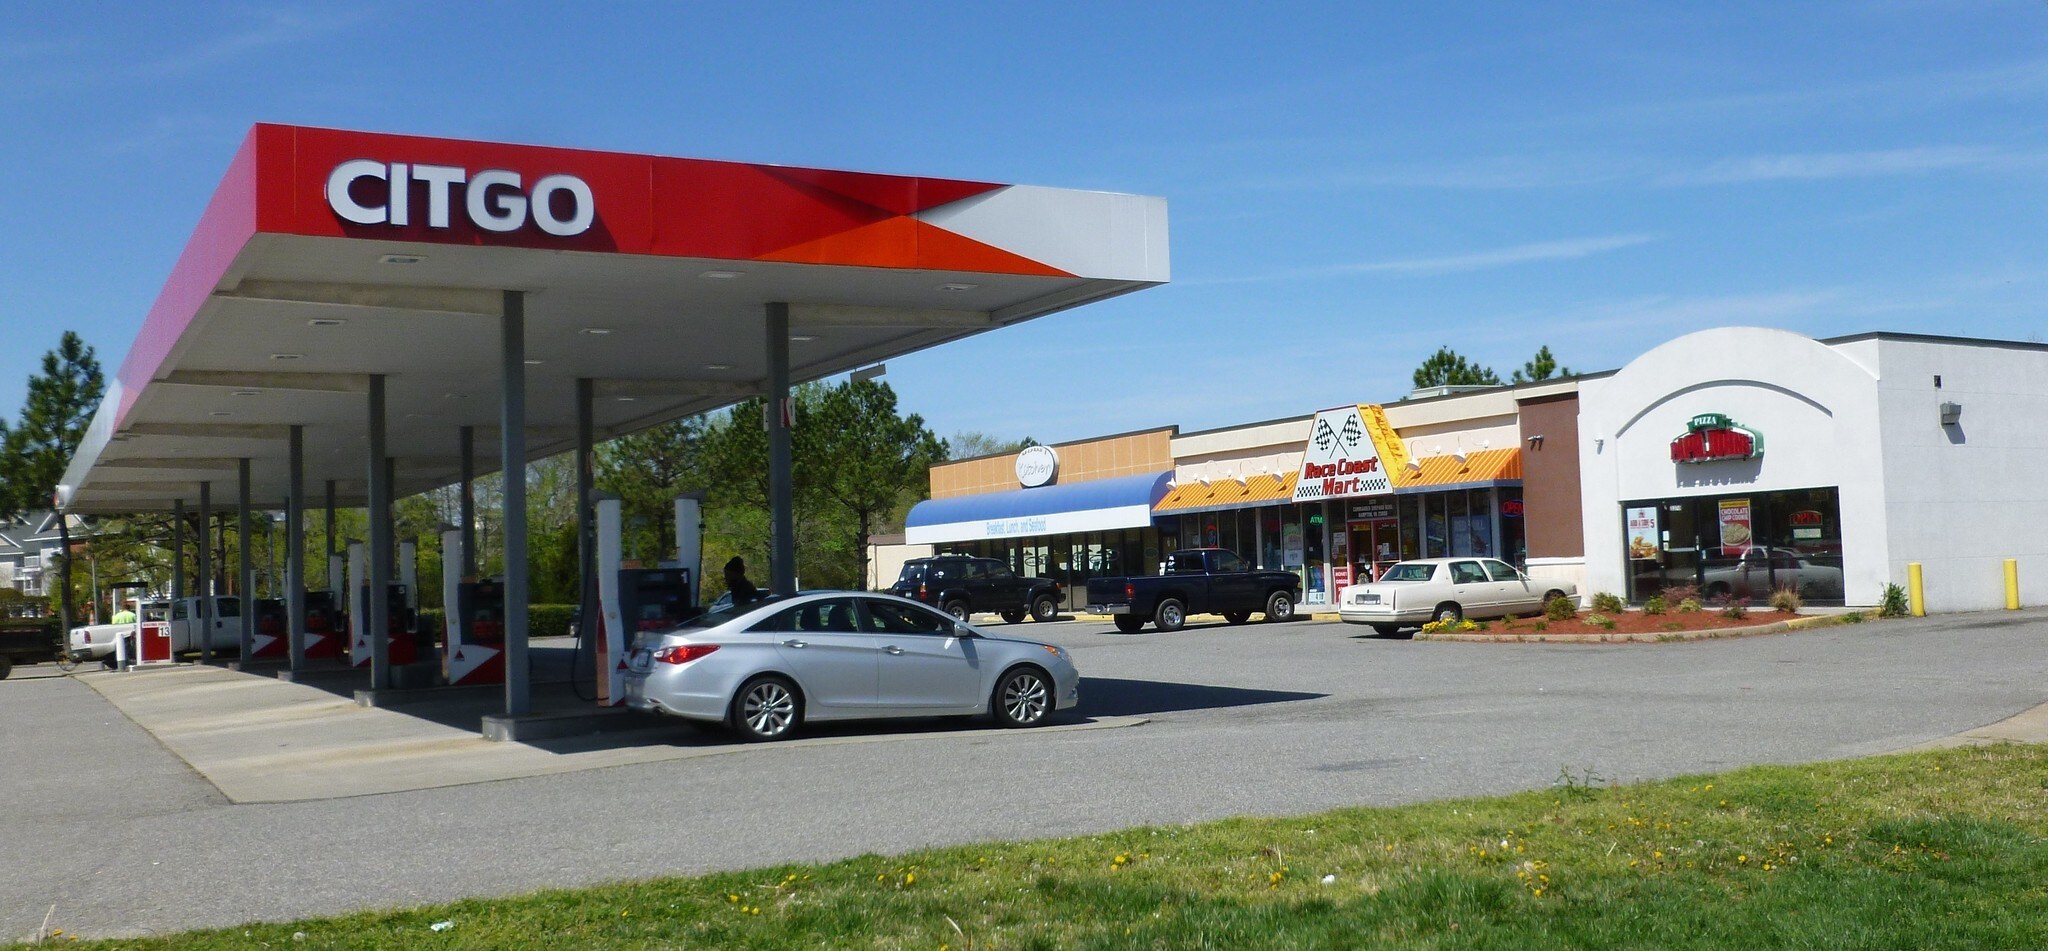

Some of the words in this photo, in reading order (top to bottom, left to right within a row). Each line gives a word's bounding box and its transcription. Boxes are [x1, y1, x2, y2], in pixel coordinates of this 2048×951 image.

[326, 158, 594, 236] CITGO
[1694, 416, 1716, 425] PIZZA
[1304, 462, 1337, 479] Race
[1337, 456, 1378, 475] Coast
[1321, 477, 1360, 496] Mart
[1503, 502, 1523, 514] OPEN
[1721, 507, 1748, 515] CHOCOLATE
[1310, 516, 1323, 524] ATM
[1733, 512, 1748, 520] COOKIE
[1792, 512, 1819, 524] OPEN
[1020, 519, 1028, 533] and
[1029, 517, 1046, 531] Seafood
[160, 626, 170, 636] 13
